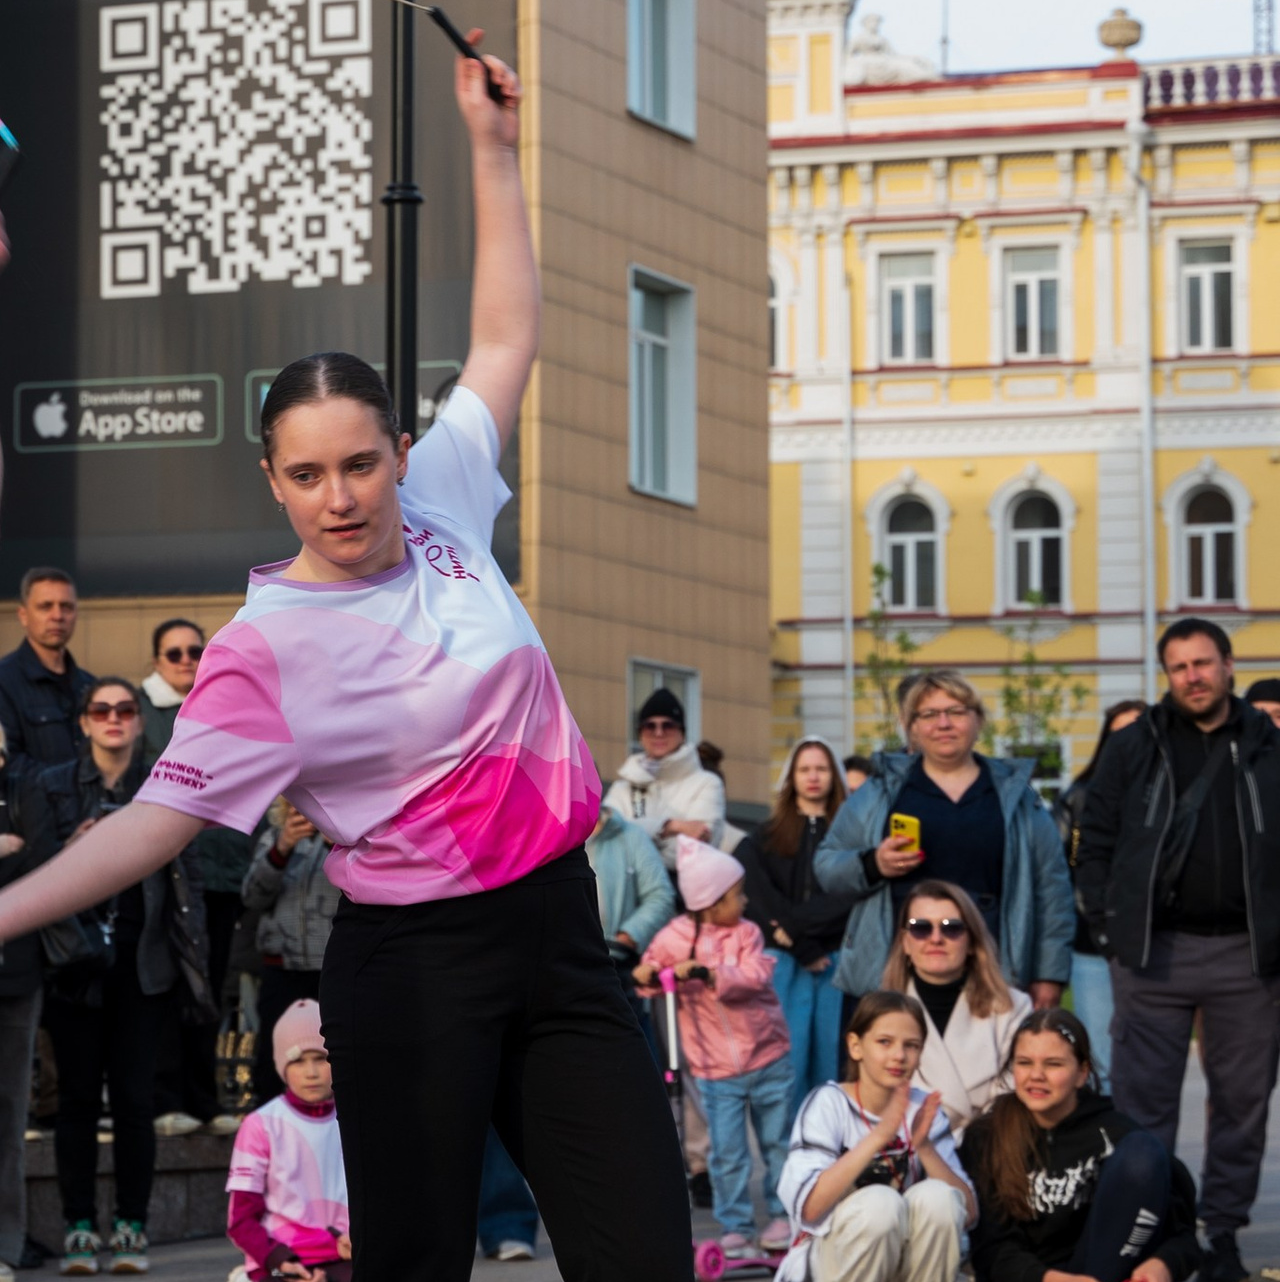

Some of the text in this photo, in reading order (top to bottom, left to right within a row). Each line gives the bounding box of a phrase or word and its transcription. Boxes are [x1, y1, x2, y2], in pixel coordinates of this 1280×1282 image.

[78, 386, 203, 407] Download on the
